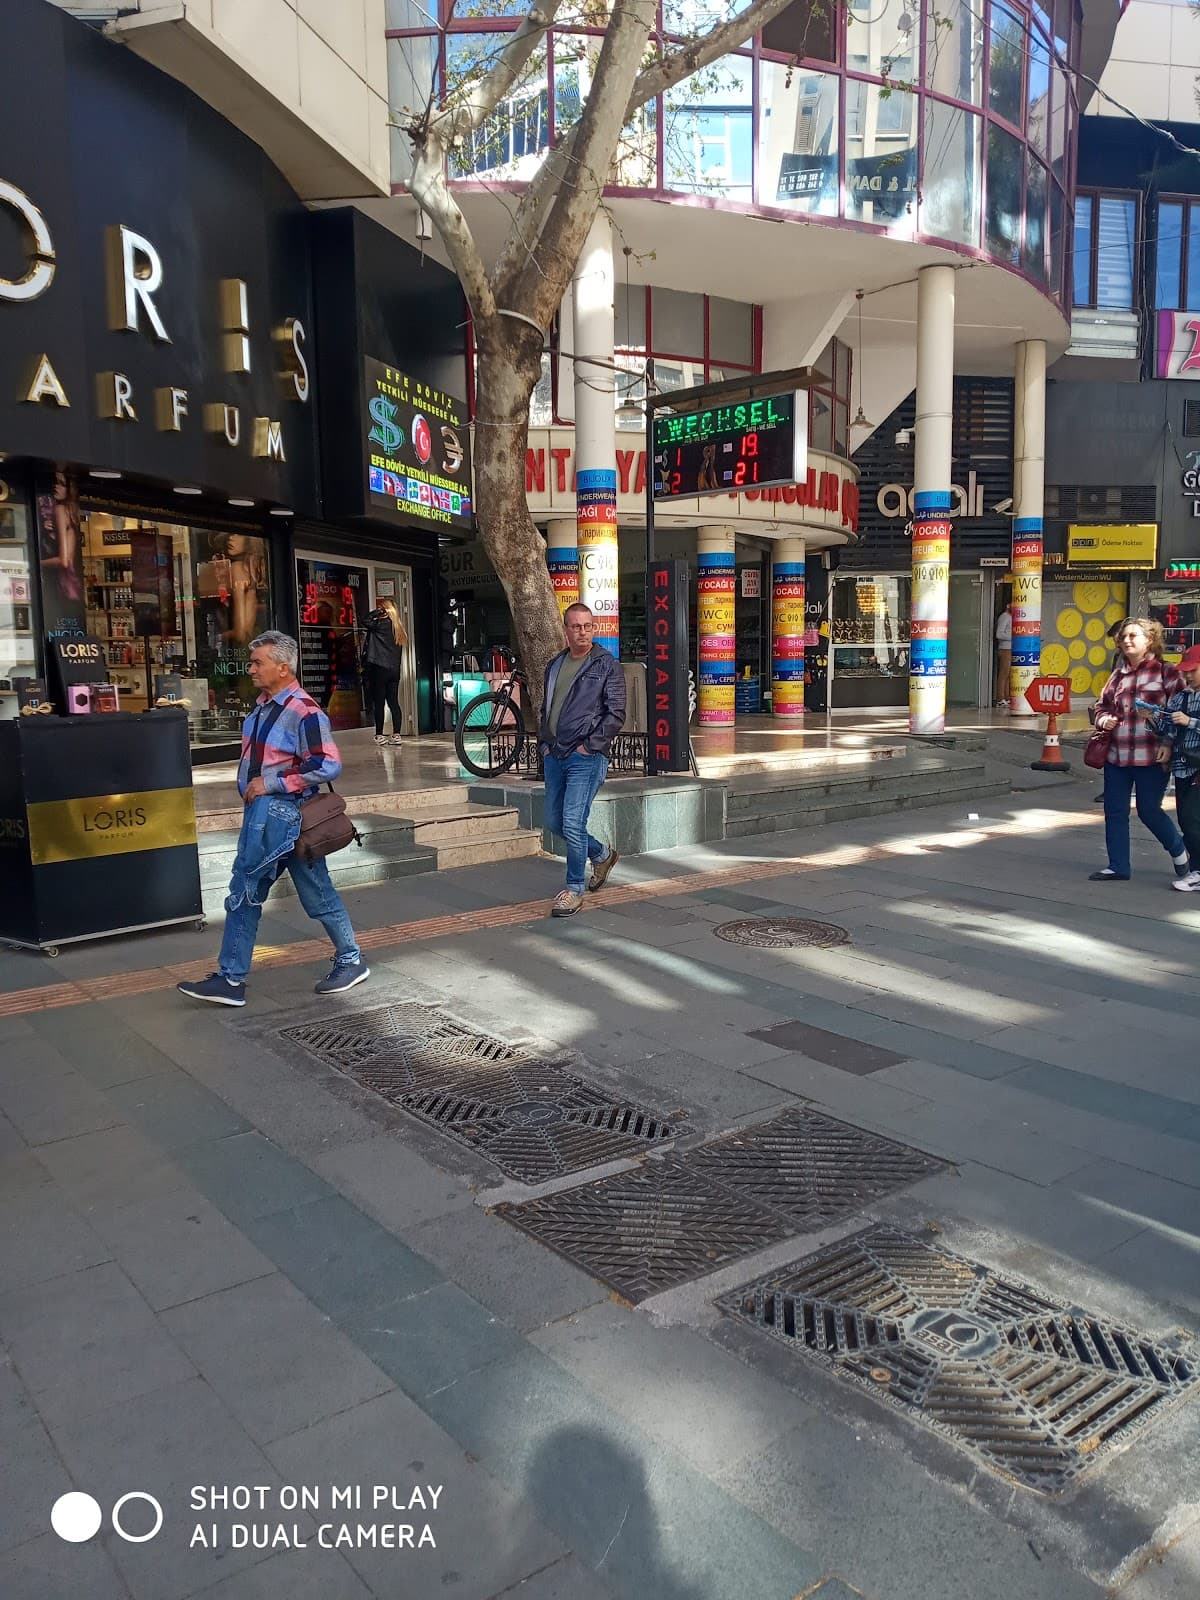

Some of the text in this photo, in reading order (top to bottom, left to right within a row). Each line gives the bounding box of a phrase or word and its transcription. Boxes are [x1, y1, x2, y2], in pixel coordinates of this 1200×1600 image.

[386, 368, 409, 388] EFE
[667, 400, 779, 437] WECHSEL
[371, 454, 385, 468] EFE
[397, 499, 453, 524] EXCHANGE OFFICE
[918, 523, 947, 536] OCAĞI
[1015, 543, 1039, 554] OCAĞI
[704, 580, 729, 589] OCAĞI
[776, 585, 801, 595] OCAĞI
[1018, 577, 1039, 590] WC
[703, 609, 723, 620] WC
[60, 643, 99, 658] LORIS
[655, 570, 670, 761] EXCHANGE
[1038, 684, 1065, 702] WC
[83, 807, 147, 832] LORIS
